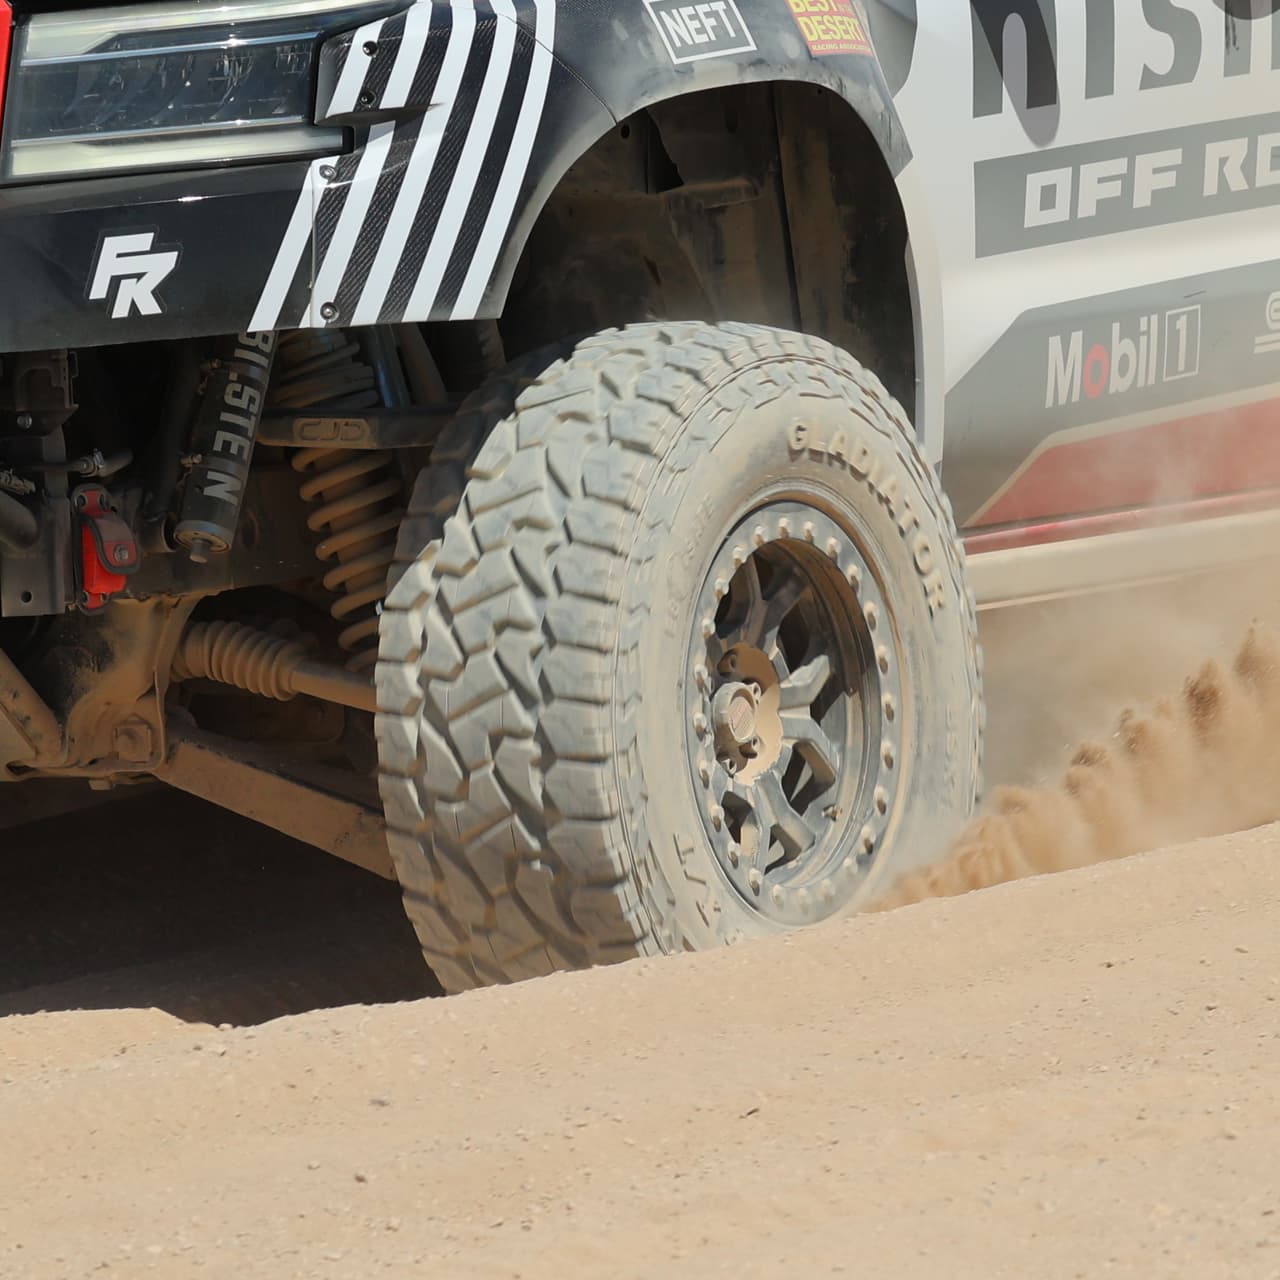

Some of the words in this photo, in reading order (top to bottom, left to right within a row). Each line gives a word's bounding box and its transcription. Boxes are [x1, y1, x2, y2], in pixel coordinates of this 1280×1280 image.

[660, 1, 736, 47] NEFT
[797, 15, 866, 41] DESERT
[1024, 148, 1182, 228] OFF
[1045, 313, 1158, 408] Mobil
[788, 418, 944, 618] GLADIATOR
